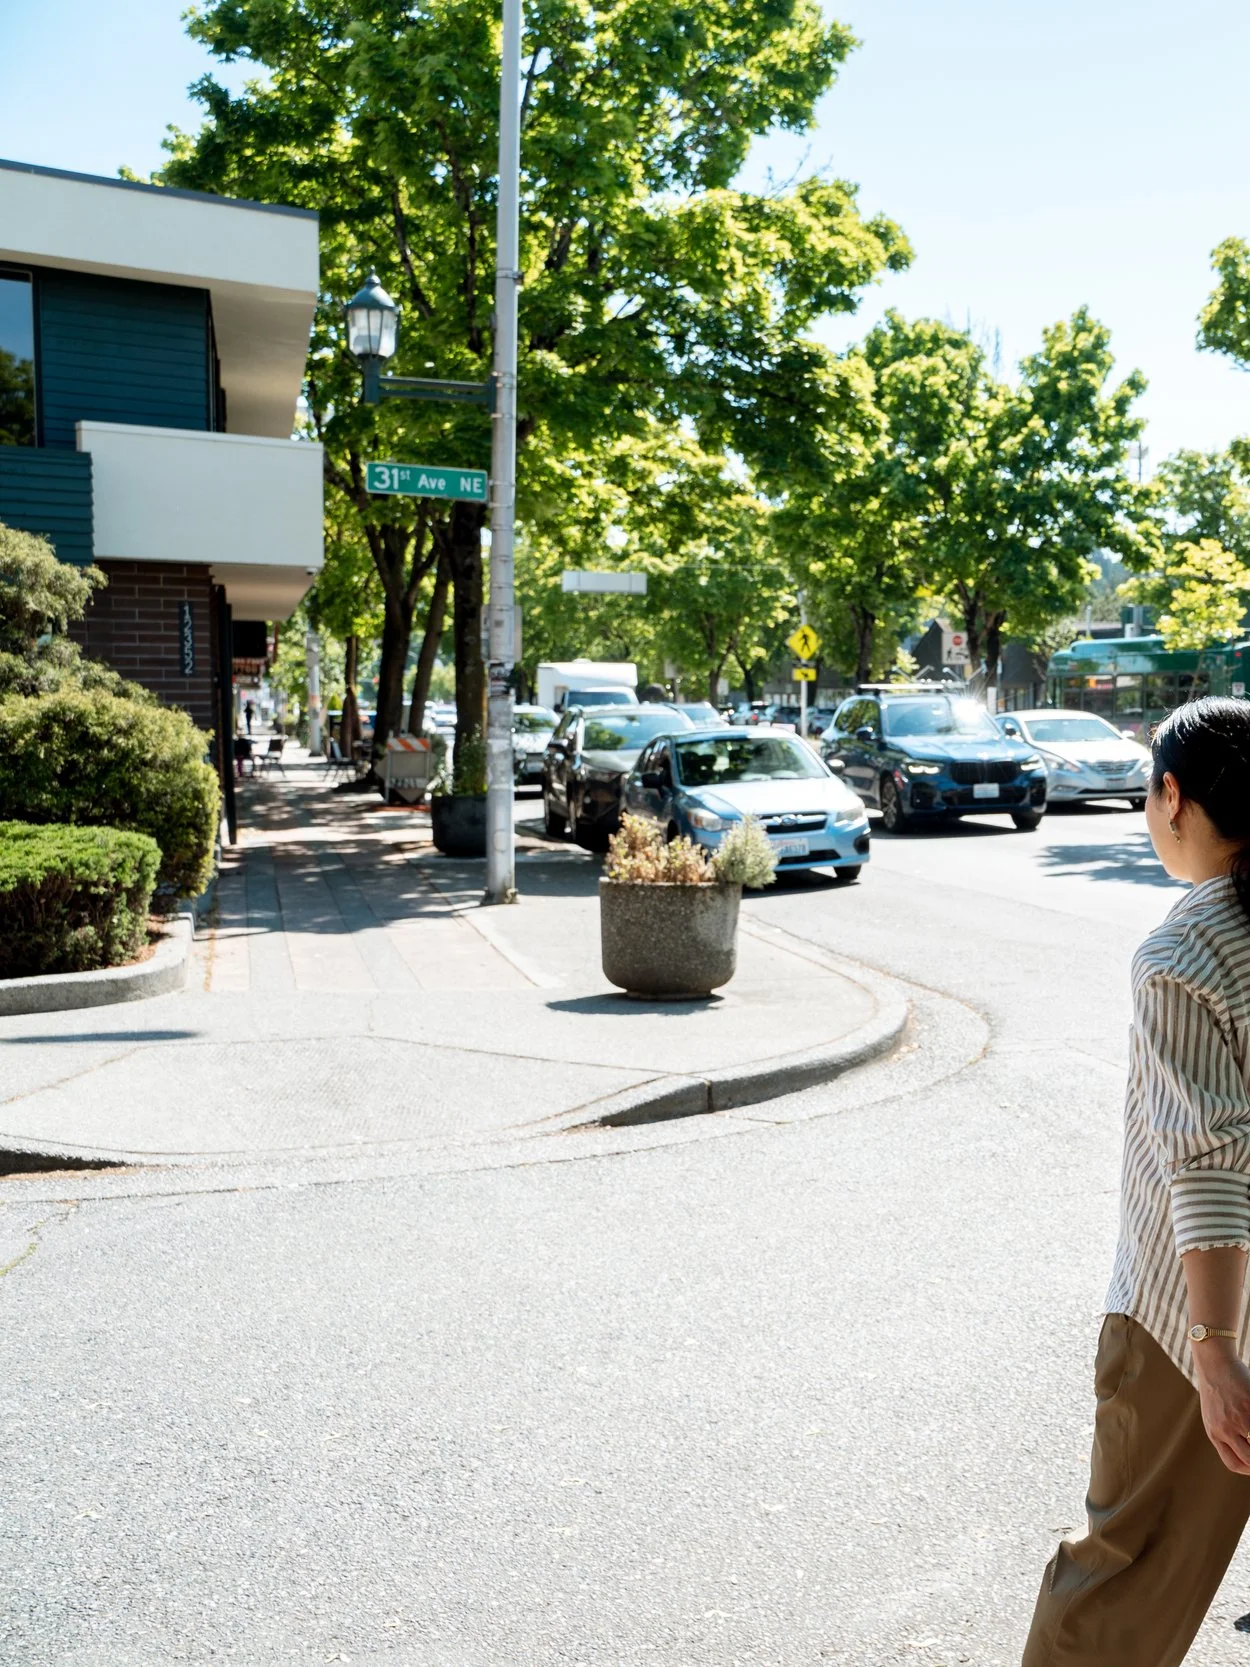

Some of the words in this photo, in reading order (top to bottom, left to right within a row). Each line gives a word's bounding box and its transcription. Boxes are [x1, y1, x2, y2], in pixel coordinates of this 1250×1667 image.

[417, 473, 447, 490] Ave
[459, 476, 483, 493] NE
[183, 603, 193, 675] 12352
